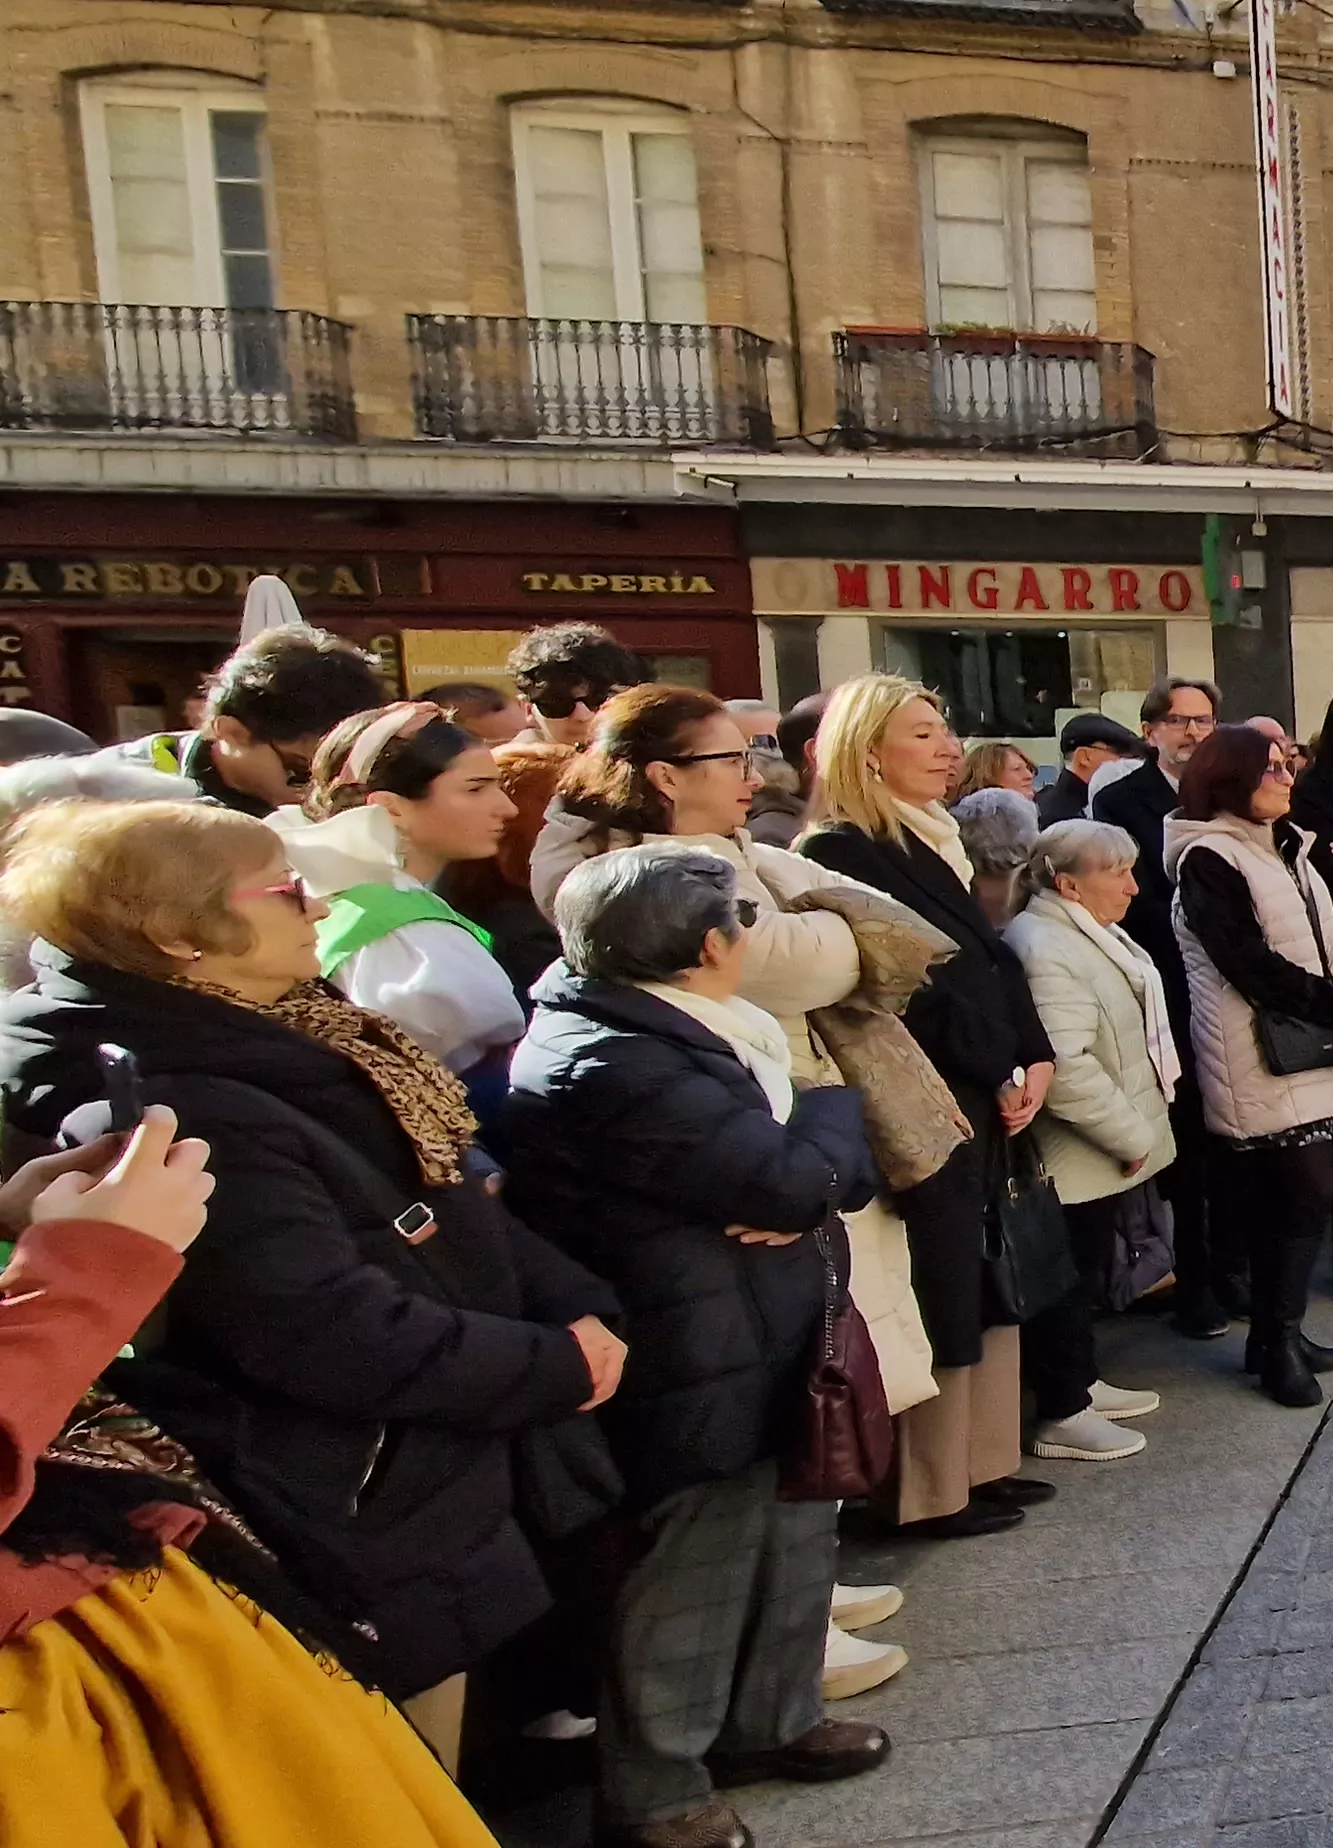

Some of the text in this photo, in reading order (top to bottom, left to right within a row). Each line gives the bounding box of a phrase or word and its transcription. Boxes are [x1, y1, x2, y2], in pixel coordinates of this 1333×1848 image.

[59, 562, 365, 597] REBOTCA
[522, 569, 716, 593] TAPERÍA
[834, 562, 1192, 612] MINGARRO
